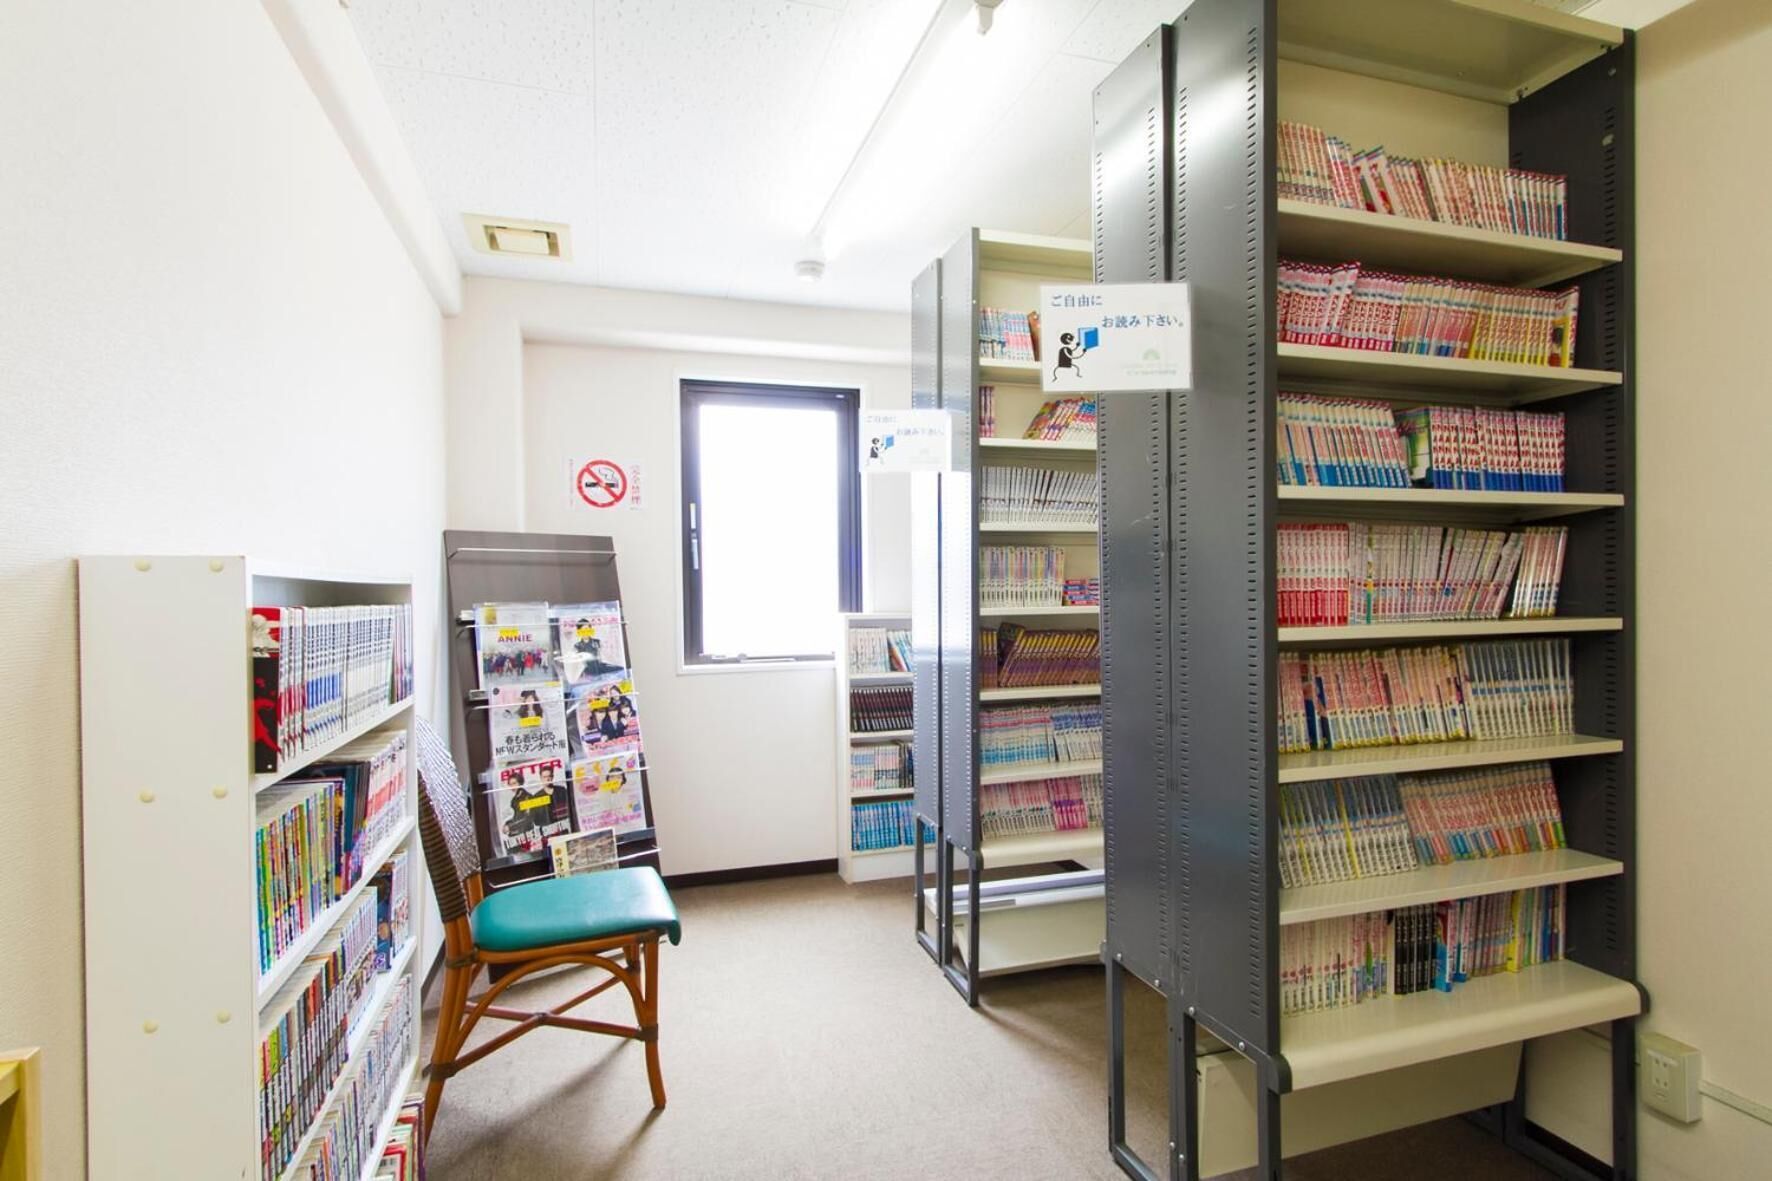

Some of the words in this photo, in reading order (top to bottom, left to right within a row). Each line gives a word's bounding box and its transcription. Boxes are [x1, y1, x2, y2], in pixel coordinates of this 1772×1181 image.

[1051, 294, 1102, 307] ご自由に
[1102, 314, 1184, 328] お読み下さい。
[498, 633, 533, 643] ANNIE
[500, 760, 562, 781] BITTER
